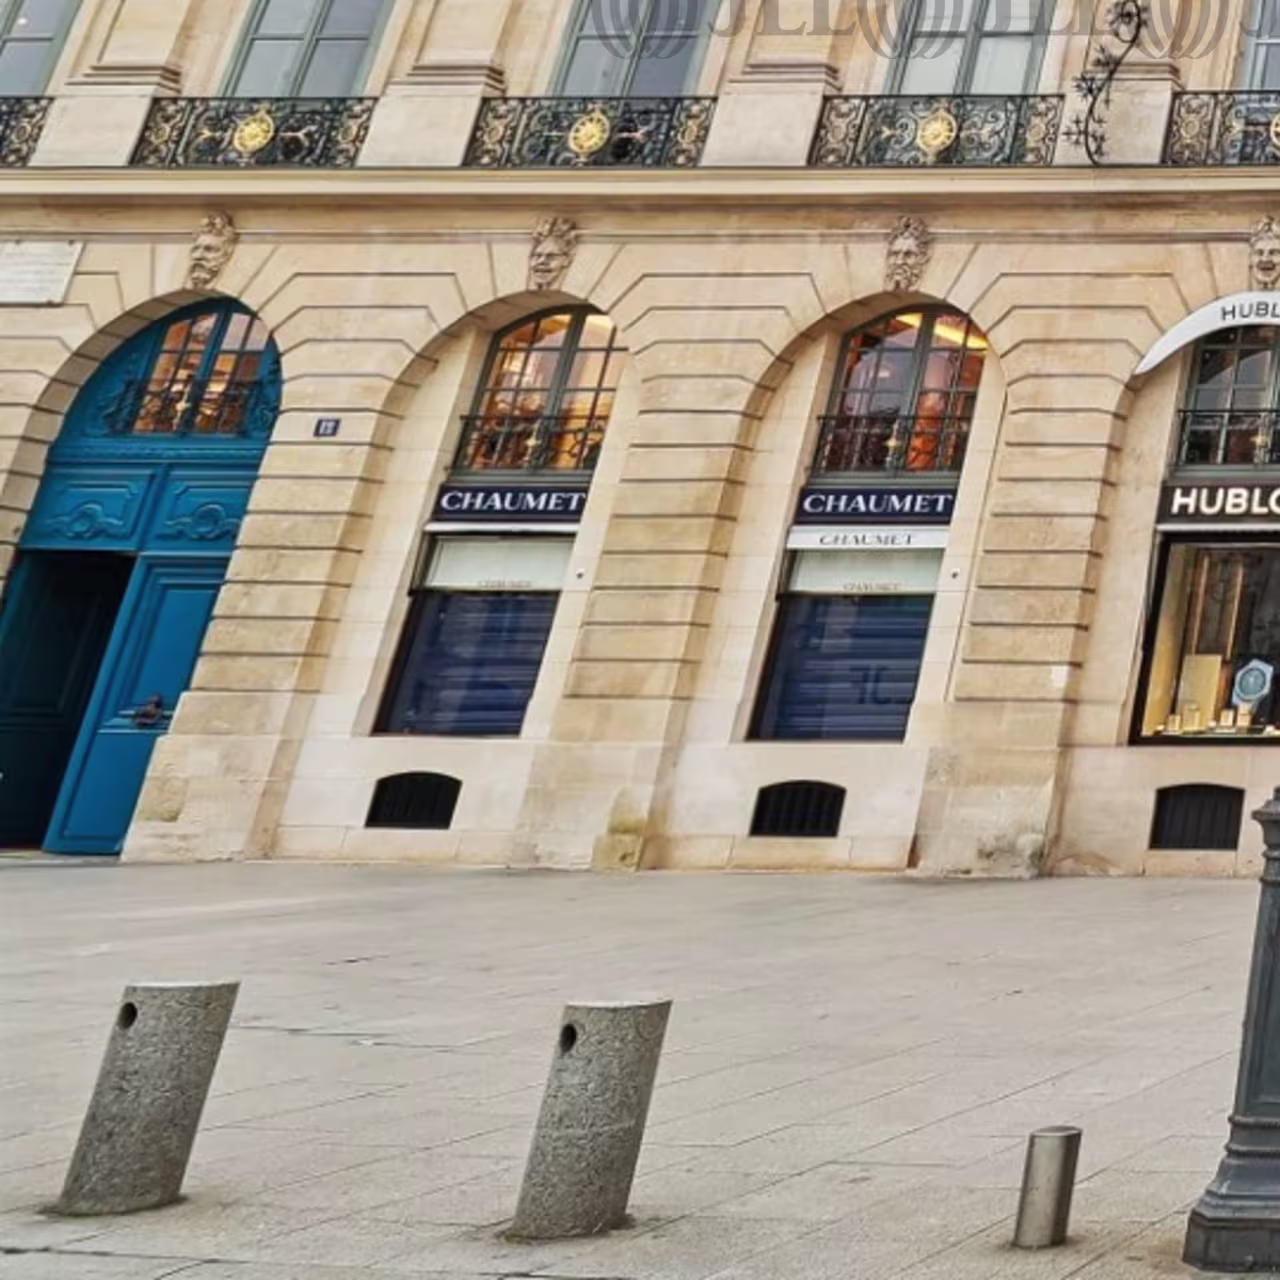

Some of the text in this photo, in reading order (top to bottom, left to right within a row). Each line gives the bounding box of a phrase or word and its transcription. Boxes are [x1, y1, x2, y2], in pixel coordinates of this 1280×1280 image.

[440, 492, 587, 511] CHAUMET
[803, 494, 954, 513] CHAUMET
[819, 534, 914, 546] CHAUMET
